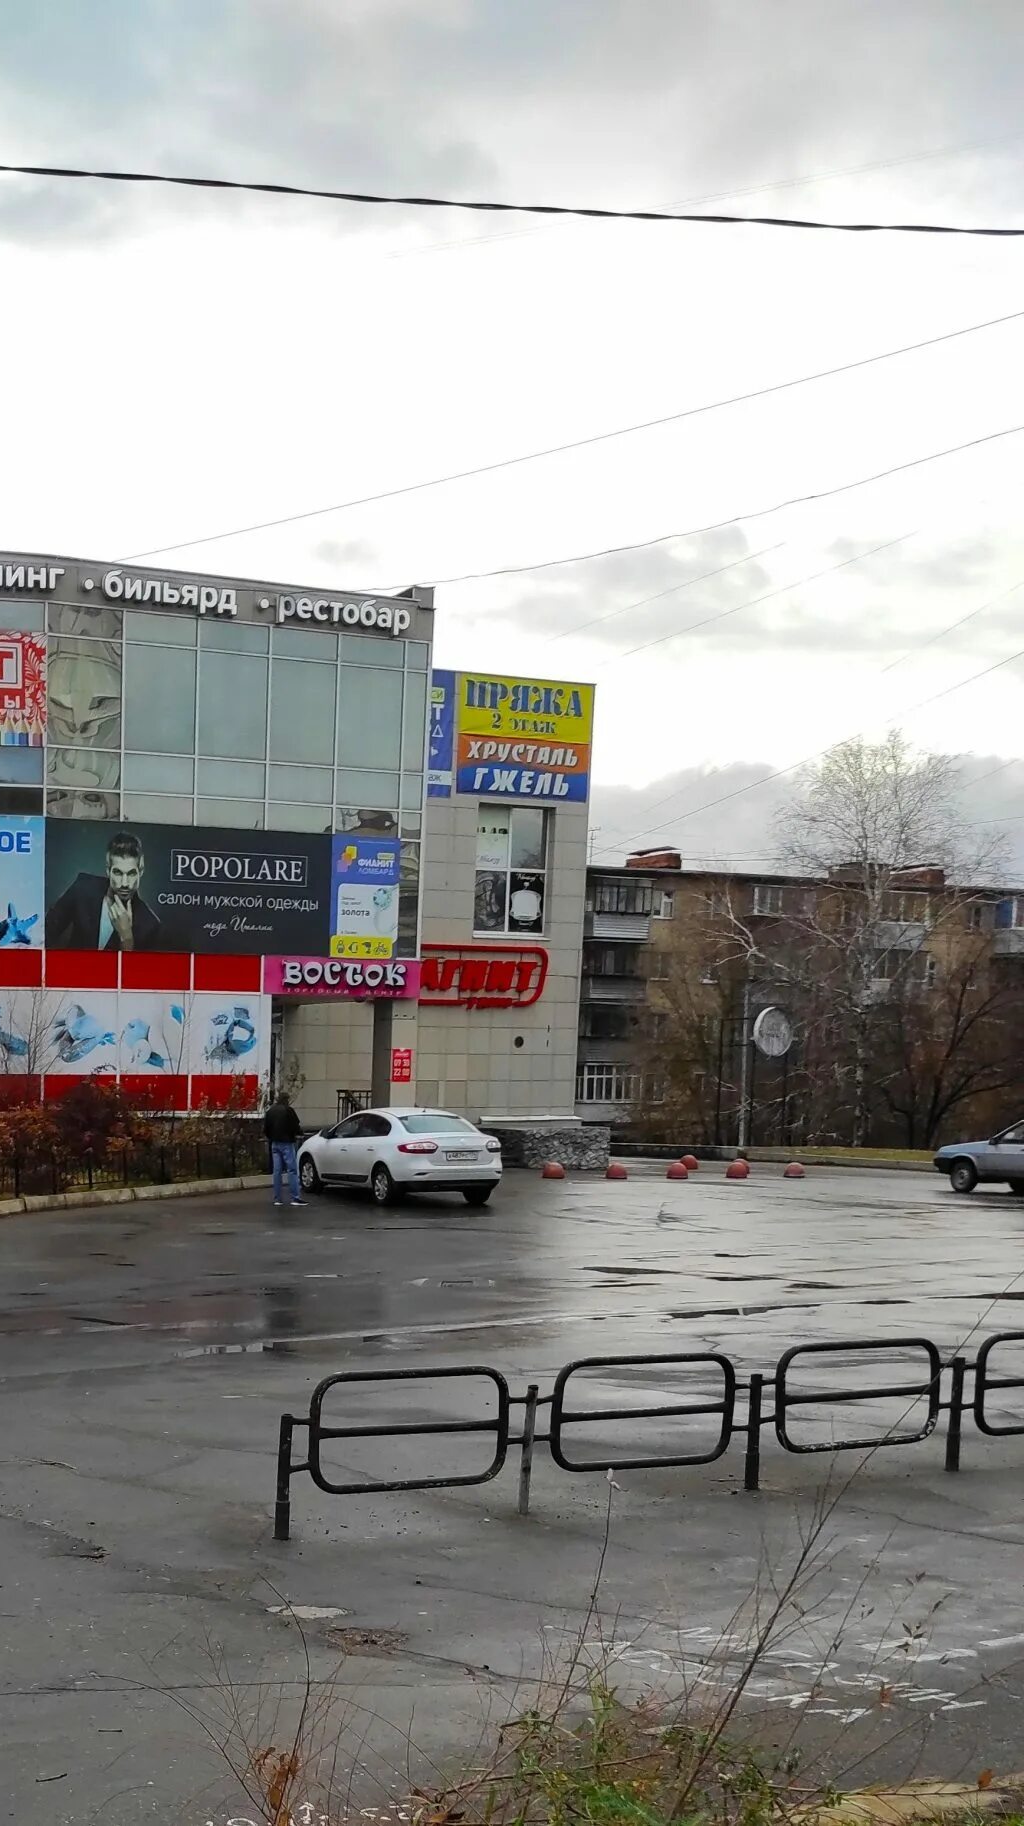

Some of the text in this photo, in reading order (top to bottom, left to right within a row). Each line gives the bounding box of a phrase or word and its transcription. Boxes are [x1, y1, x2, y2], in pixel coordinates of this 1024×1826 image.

[103, 569, 238, 616] бильярд
[277, 592, 411, 635] рестобар
[465, 679, 584, 719] ПРЯЖА
[491, 712, 502, 730] 2
[467, 741, 578, 767] ХРУСТАЛЬ
[473, 768, 570, 796] ГЖЕЛЬ
[175, 855, 303, 882] POPOLARE
[358, 859, 394, 868] ФИАНИТ
[358, 867, 394, 876] ЛОМБАРД
[157, 893, 319, 912] салон мужской одежды
[282, 960, 406, 987] ВОСТОК
